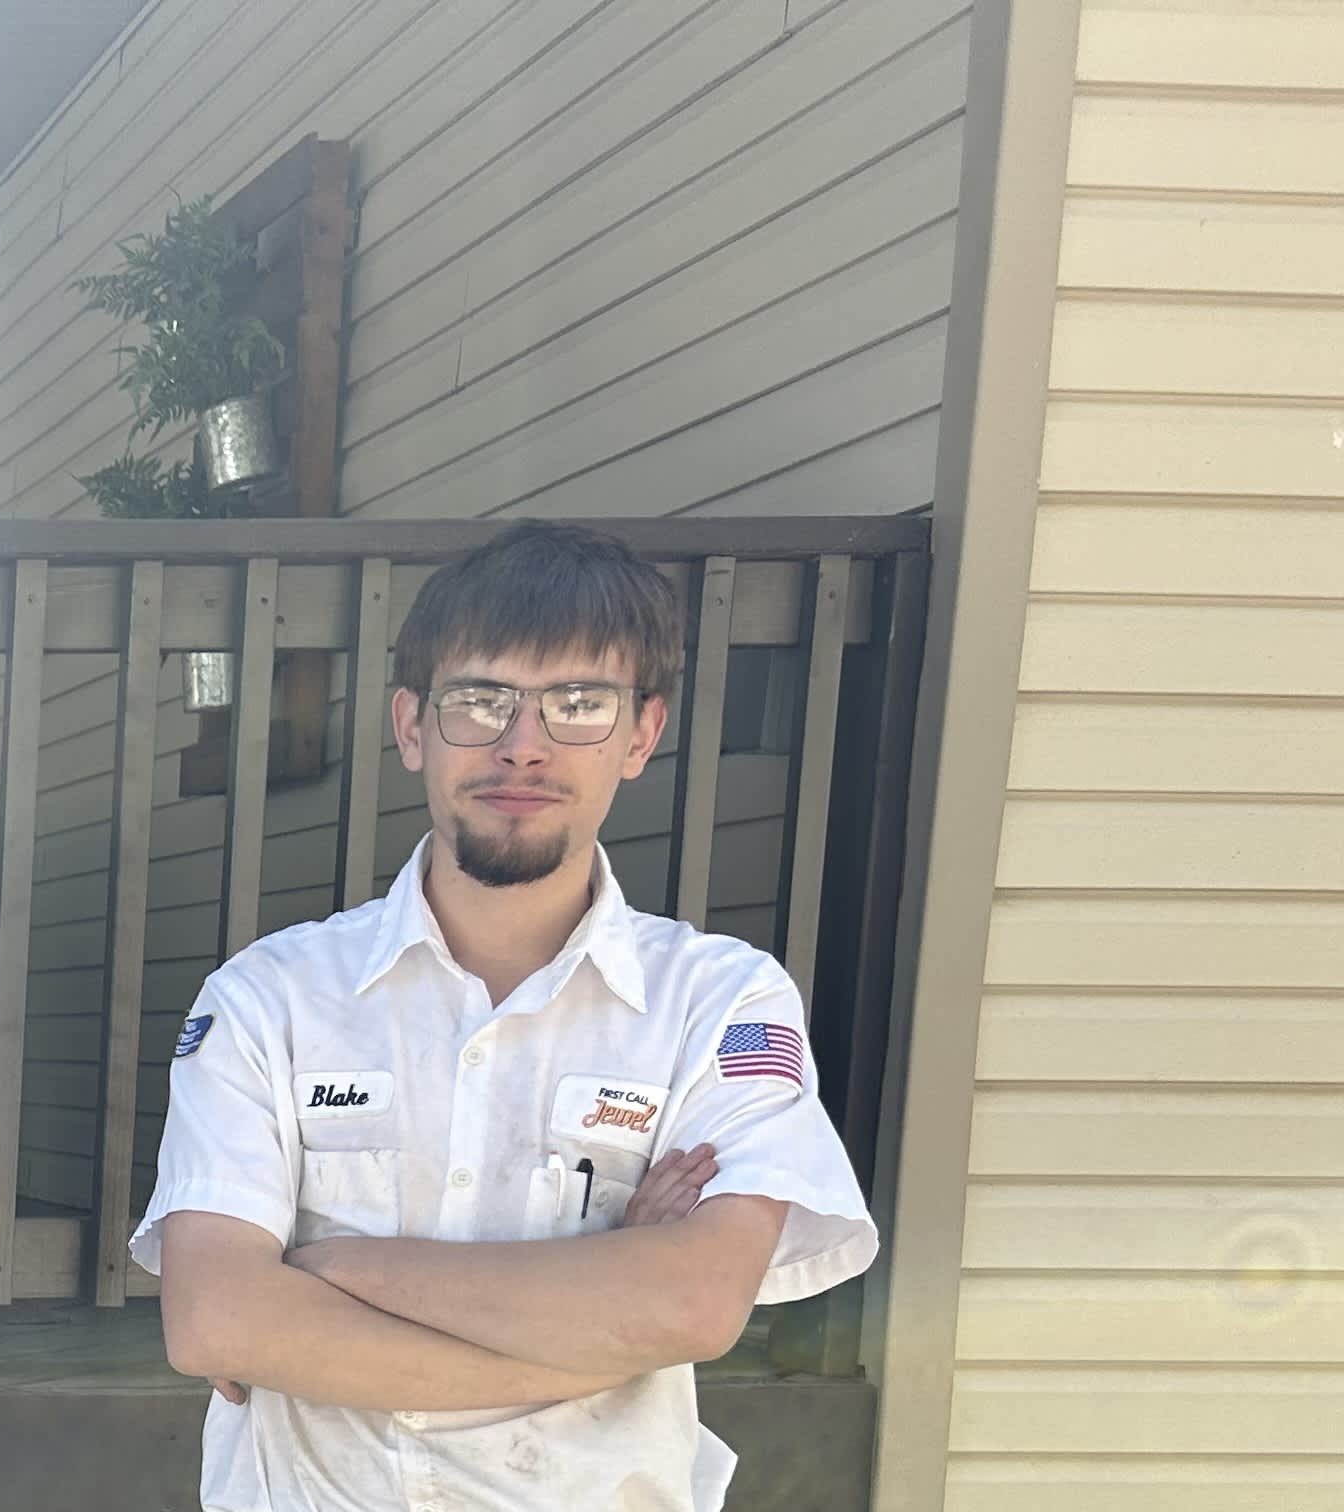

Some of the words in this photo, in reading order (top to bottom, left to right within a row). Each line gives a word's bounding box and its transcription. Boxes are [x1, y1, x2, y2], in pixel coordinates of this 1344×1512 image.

[306, 1083, 370, 1107] Blake
[598, 1087, 625, 1100] FIRST
[625, 1091, 649, 1106] CALL
[582, 1098, 658, 1133] Jewel
